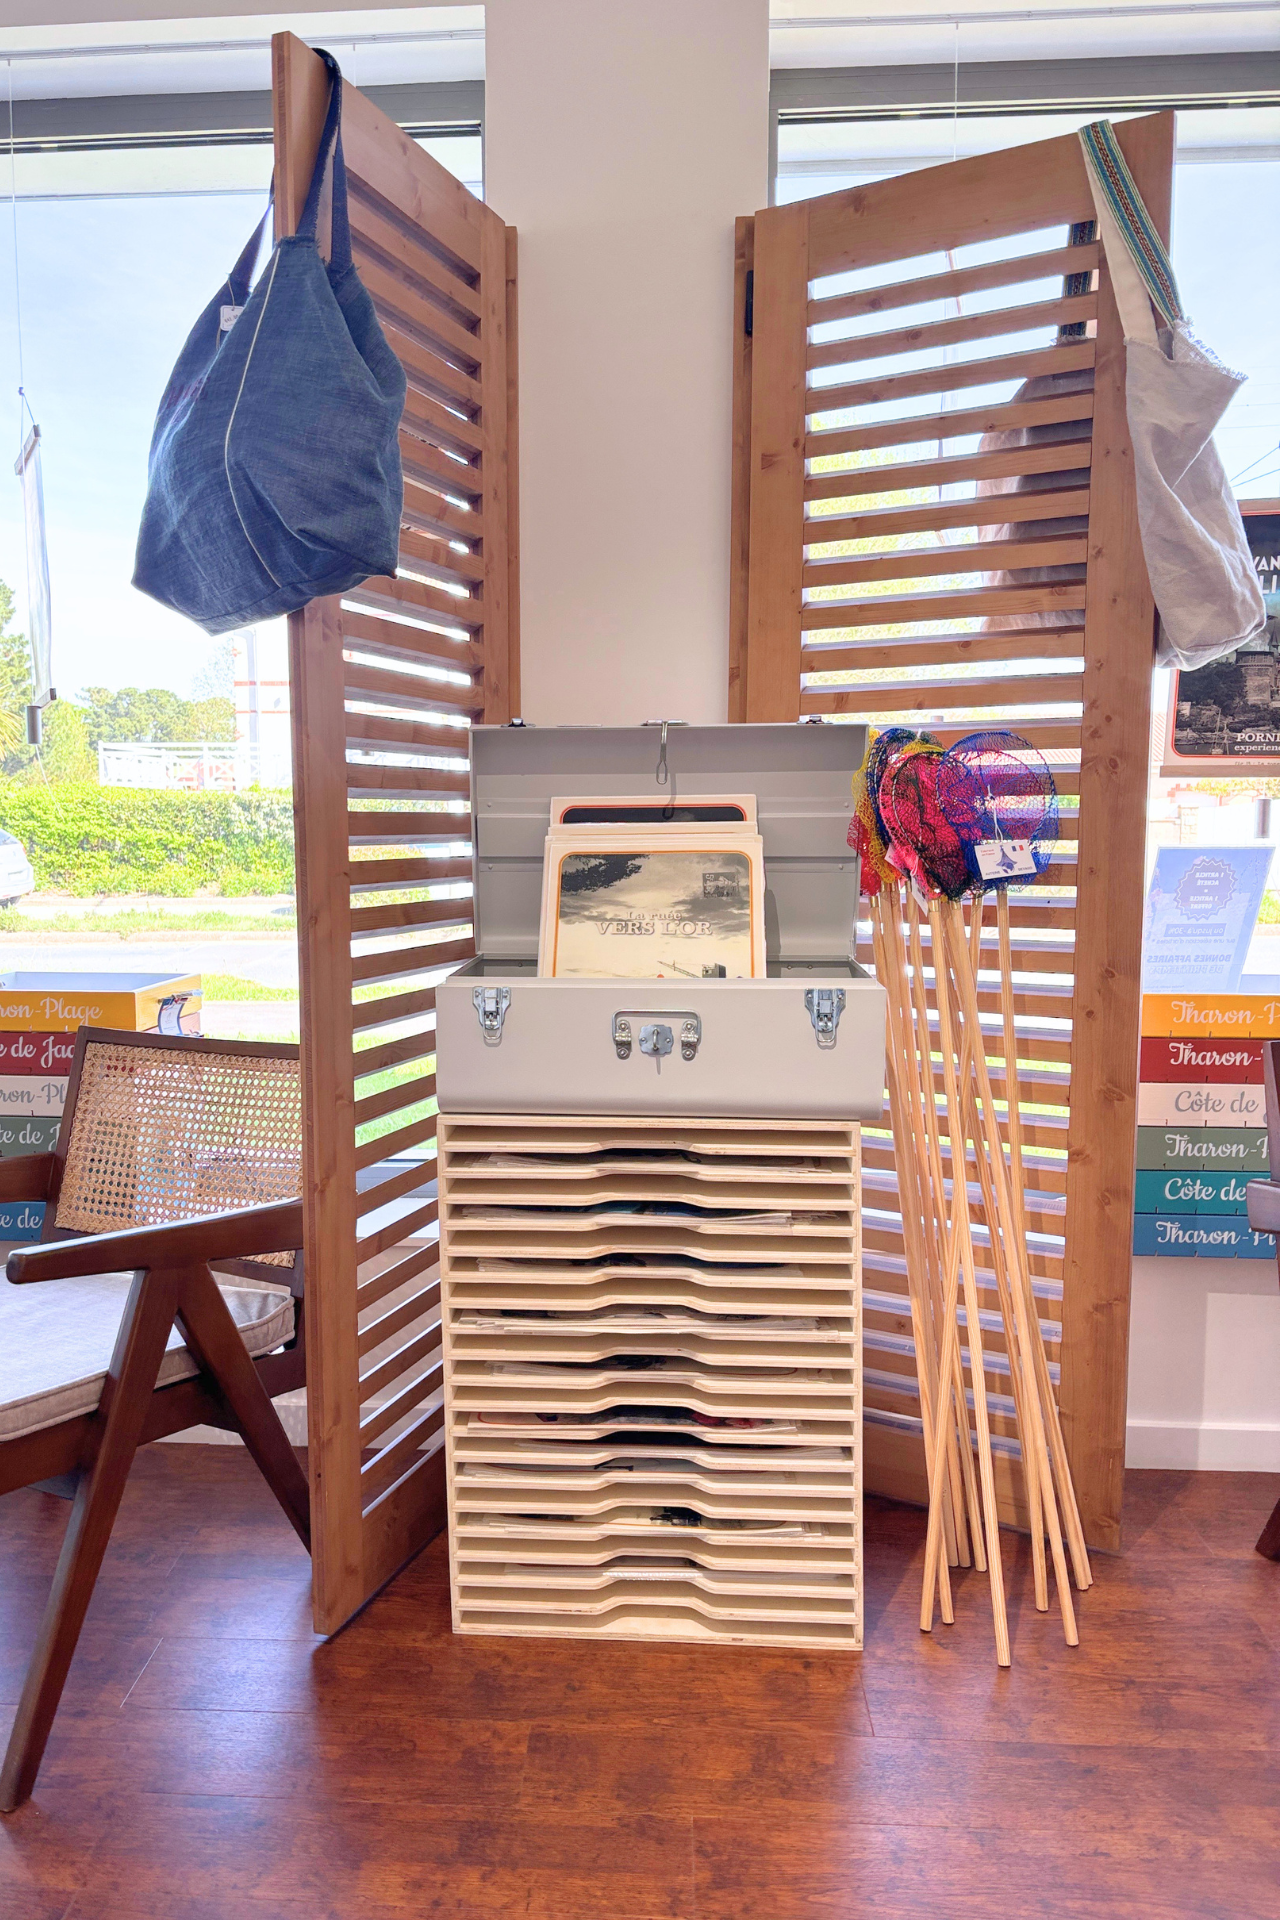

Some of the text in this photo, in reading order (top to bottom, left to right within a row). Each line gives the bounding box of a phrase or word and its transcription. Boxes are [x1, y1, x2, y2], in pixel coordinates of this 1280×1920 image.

[627, 910, 682, 920] La ruée
[595, 920, 713, 936] VERS L'OR
[11, 1036, 37, 1058] de
[1169, 1042, 1263, 1066] Tharon-
[1174, 1090, 1259, 1113] Côte de
[19, 1123, 44, 1144] de
[1164, 1177, 1246, 1201] Côte de
[17, 1208, 43, 1228] de
